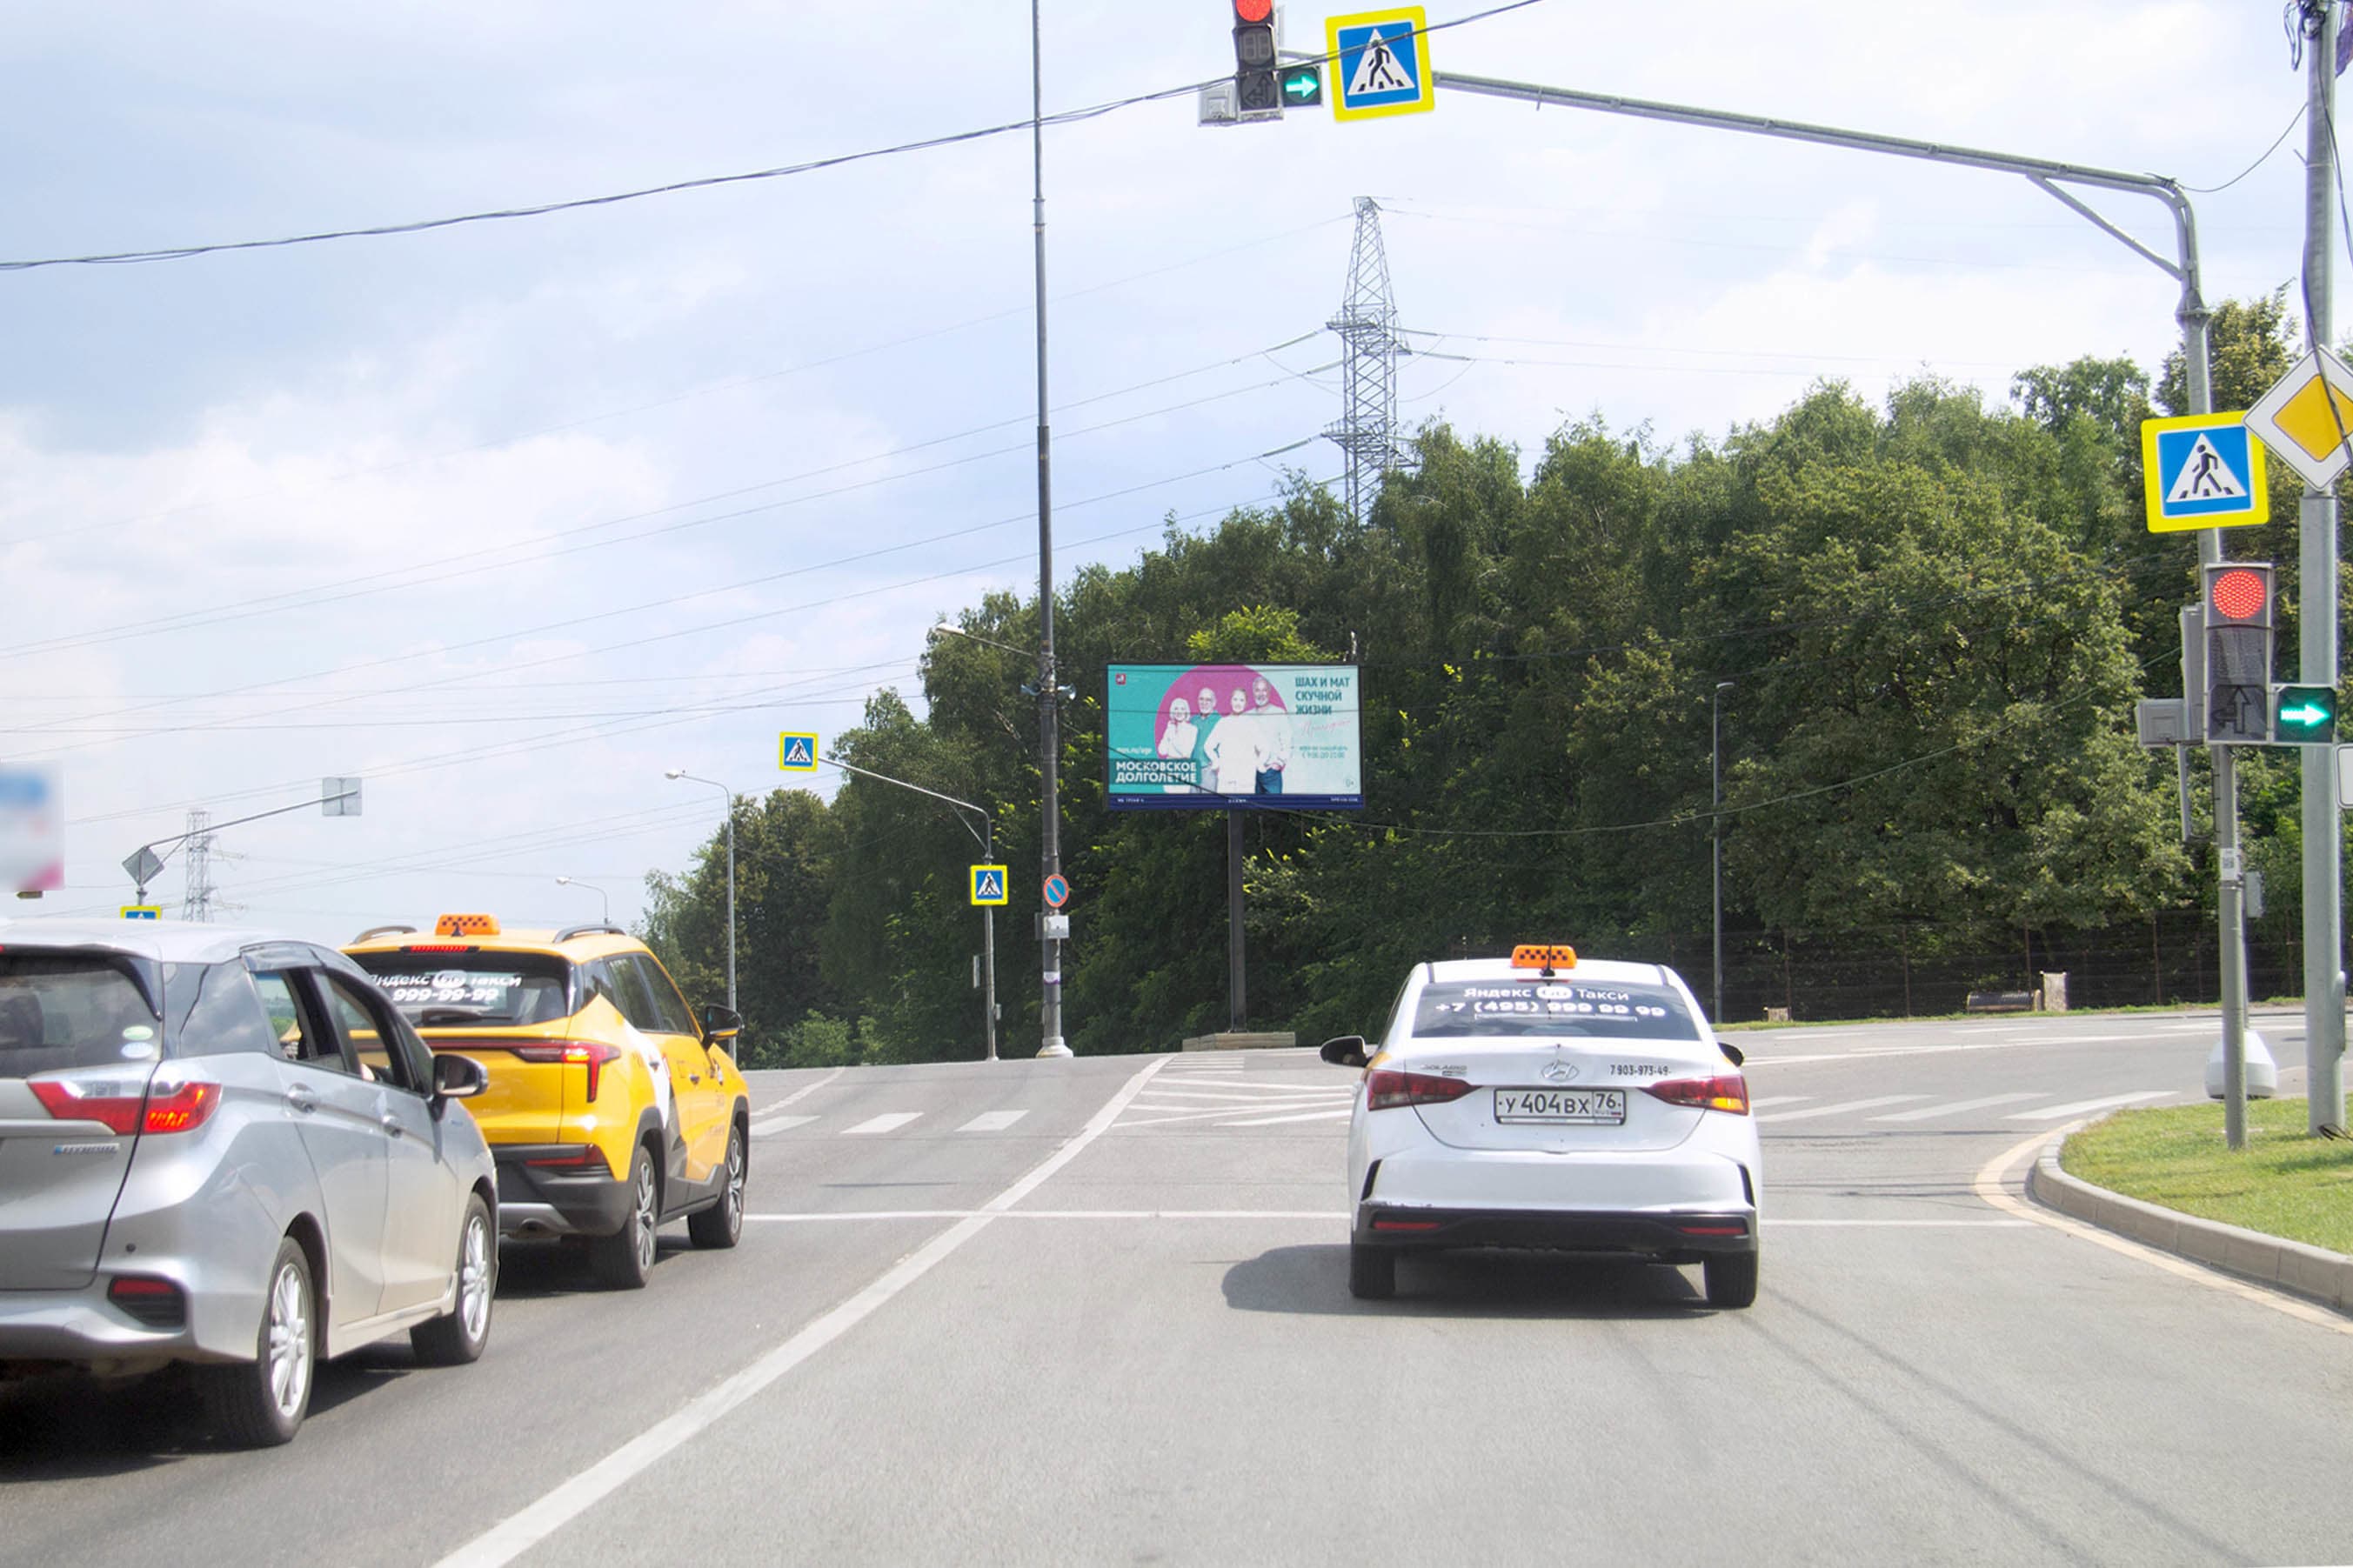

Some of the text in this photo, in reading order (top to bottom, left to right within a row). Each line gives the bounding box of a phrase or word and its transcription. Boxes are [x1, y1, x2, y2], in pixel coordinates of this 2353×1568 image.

[1295, 677, 1350, 687] ШАХ И МАТ
[1295, 689, 1342, 701] СКУЧНОЙ
[1295, 704, 1332, 715] ЖИЗНИ
[1116, 761, 1197, 771] МОСКОВСКОЕ
[1115, 772, 1197, 784] ДОЛГОЛЕТИЕ
[393, 988, 499, 1002] 999-99-99
[1463, 987, 1532, 998] Яндекс
[1576, 988, 1629, 1001] Такси
[1435, 1002, 1467, 1012] +7
[1474, 1000, 1539, 1013] (495)
[1595, 1093, 1616, 1109] 76
